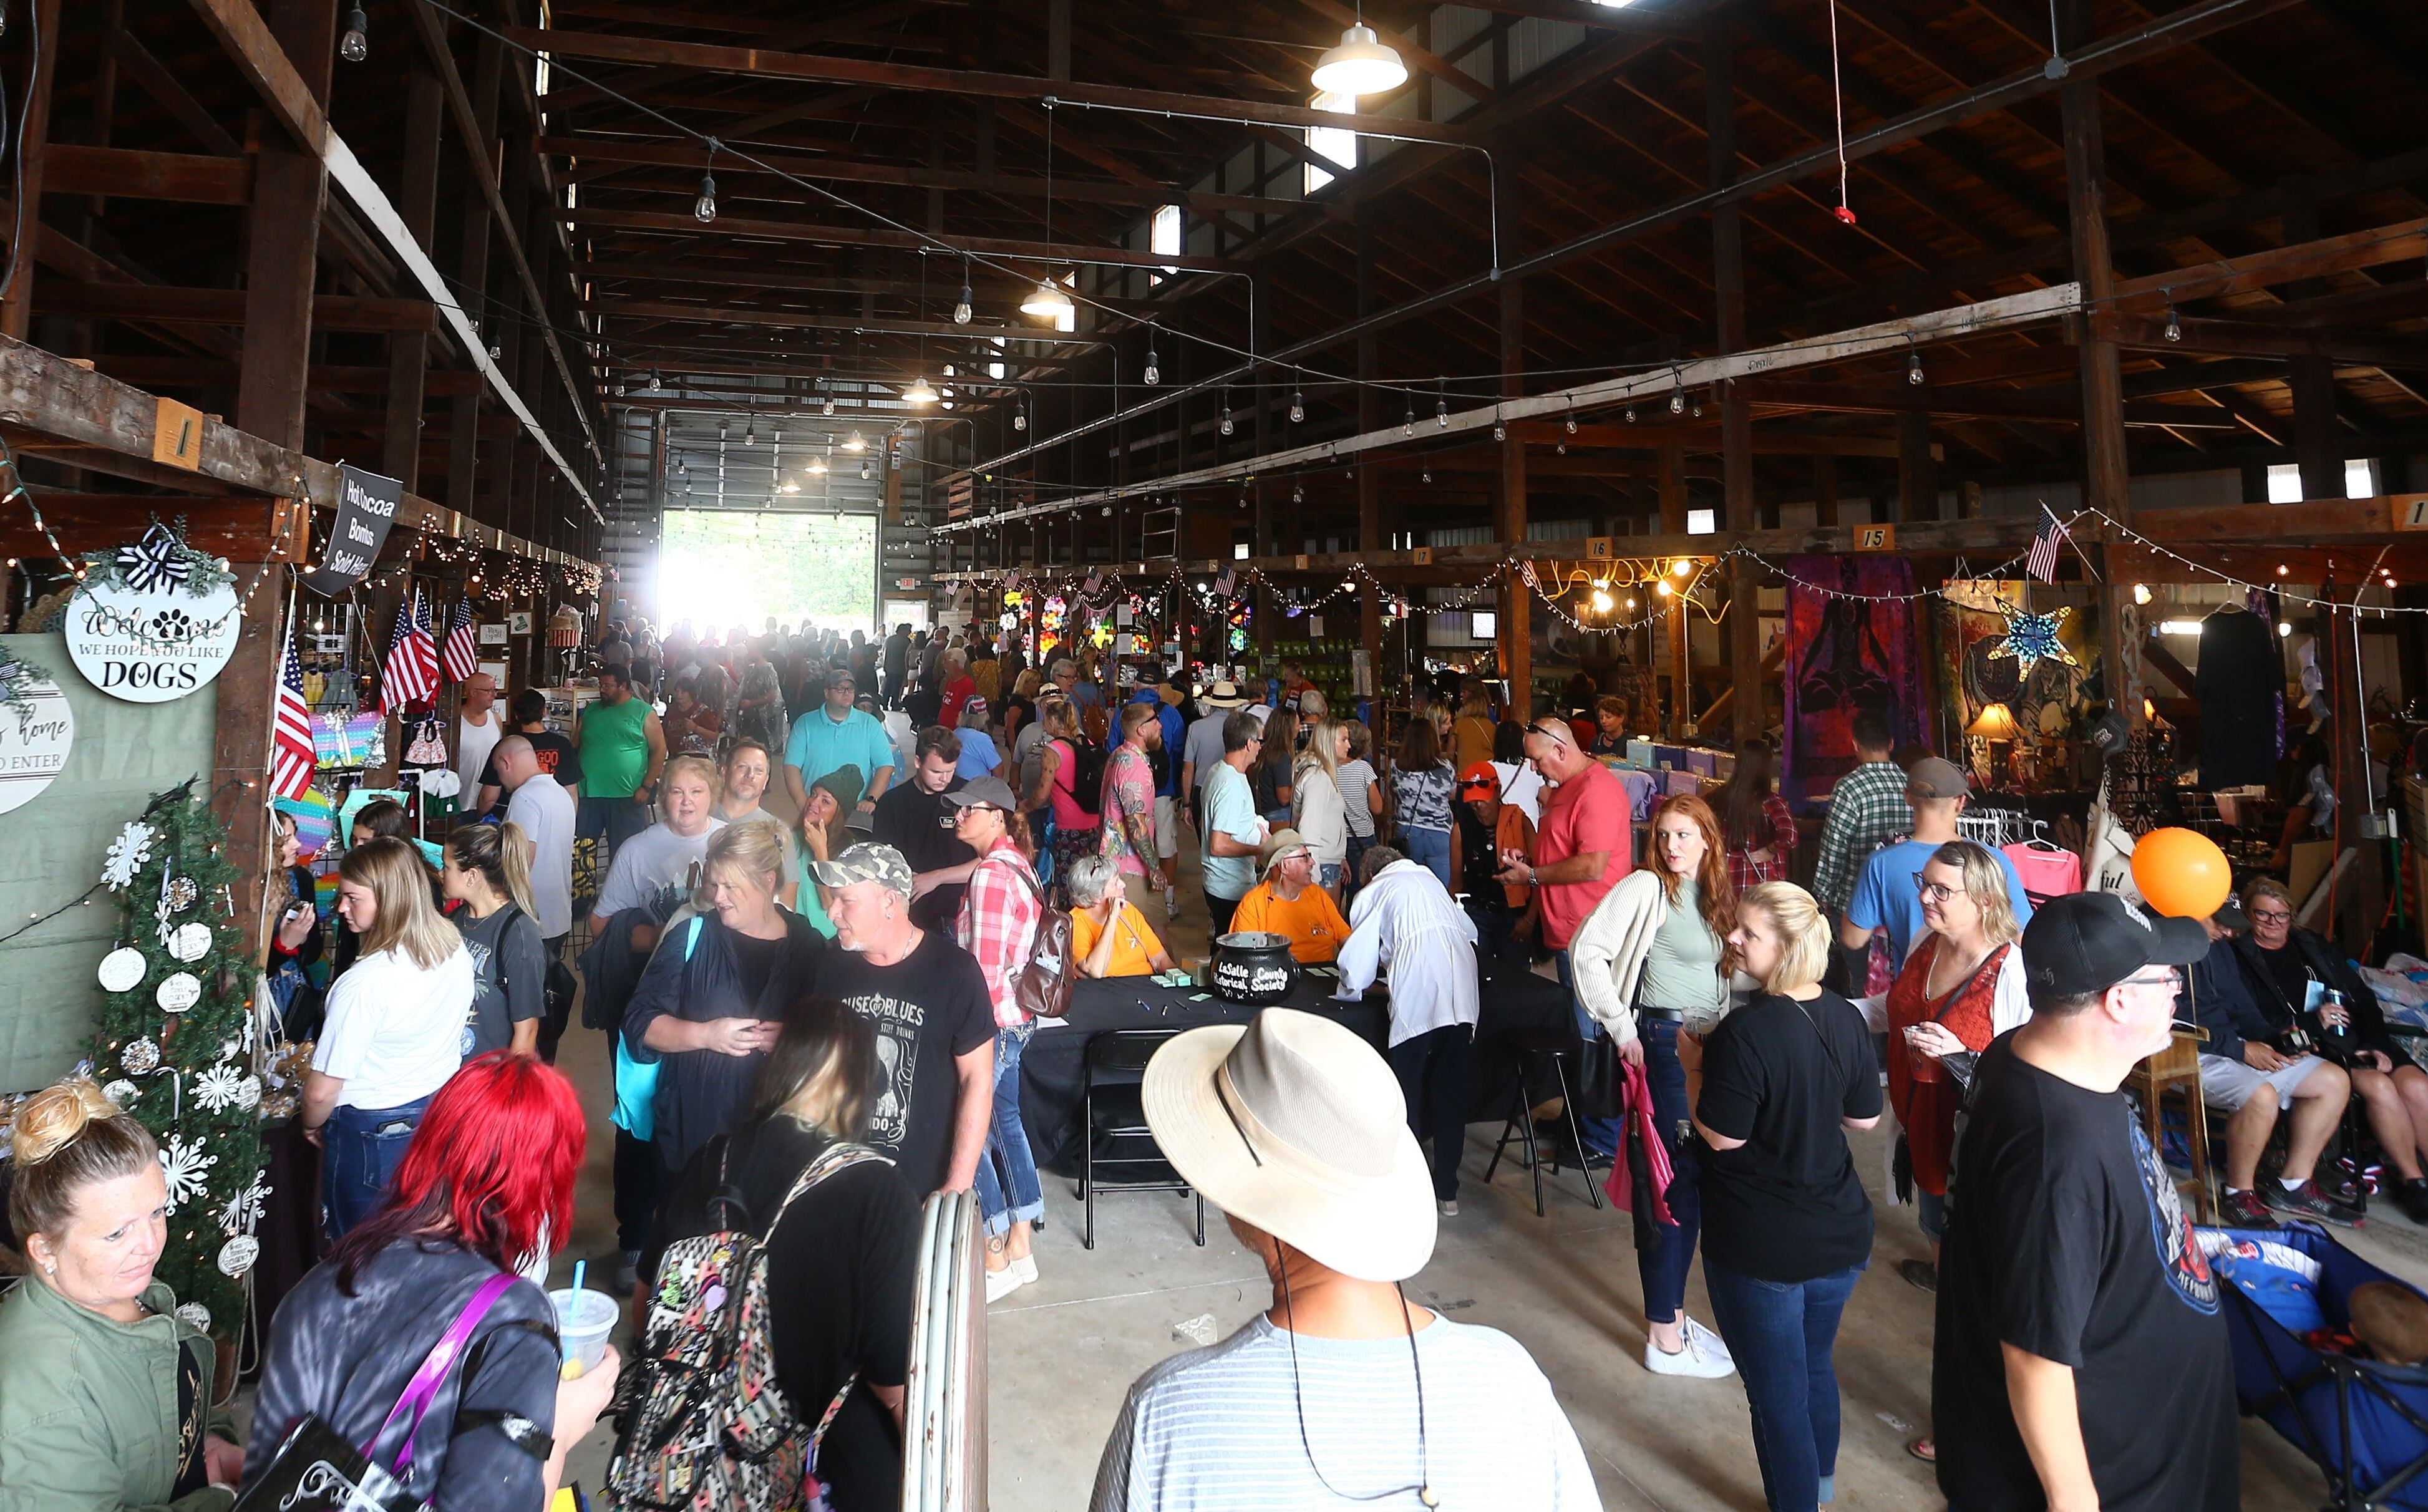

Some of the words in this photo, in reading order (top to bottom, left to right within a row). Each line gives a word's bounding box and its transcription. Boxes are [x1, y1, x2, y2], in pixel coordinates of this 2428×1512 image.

[346, 478, 361, 507] Hot
[359, 487, 396, 518] Cocoa
[347, 516, 375, 548] Bombs
[1864, 531, 1883, 546] 15
[1418, 551, 1427, 562] 17
[1593, 542, 1605, 555] 16
[329, 549, 356, 574] Sold
[80, 605, 226, 637] Welcme
[79, 644, 102, 655] WE
[105, 644, 148, 656] HOPE
[153, 645, 185, 657] YOU
[188, 646, 224, 658] LIKE
[100, 661, 198, 689] DOGS
[18, 702, 69, 746] home
[11, 754, 61, 770] ENTER
[1218, 961, 1249, 978] LaSalle
[1256, 966, 1288, 982] County
[1250, 977, 1286, 991] Society
[841, 996, 871, 1013] USE
[884, 997, 925, 1027] BLUES
[880, 1022, 894, 1034] STIFF
[896, 1025, 915, 1040] DRINKS
